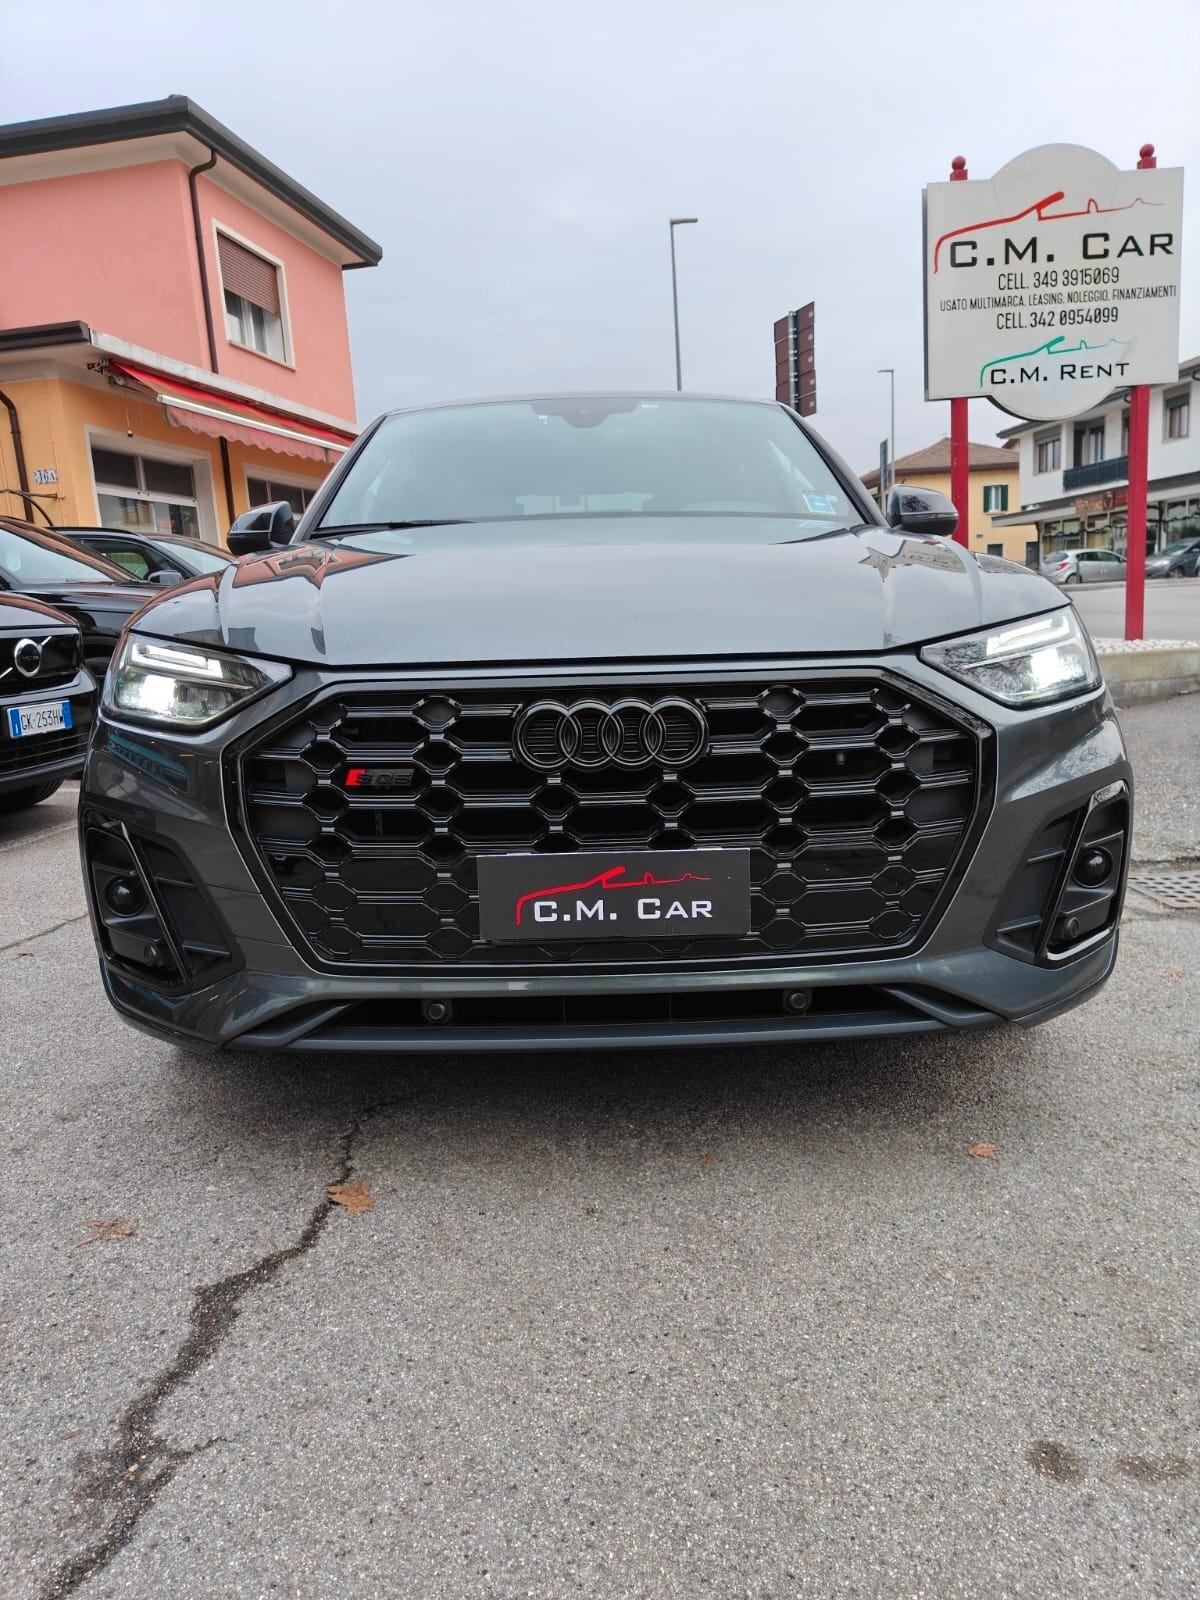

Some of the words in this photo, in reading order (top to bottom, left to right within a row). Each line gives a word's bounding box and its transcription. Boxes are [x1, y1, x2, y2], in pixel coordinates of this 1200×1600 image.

[950, 236, 1054, 268] C.M.
[998, 272, 1029, 291] CELL.
[1033, 270, 1058, 288] 349
[1062, 266, 1120, 287] 3915069
[940, 298, 968, 312] USATO
[1112, 285, 1177, 301] FINANZIAMENTI
[996, 312, 1027, 330] CELL.
[1029, 311, 1056, 328] 342
[1059, 306, 1119, 326] 0954099
[990, 366, 1048, 385] C.M.
[533, 899, 618, 922] C.M.
